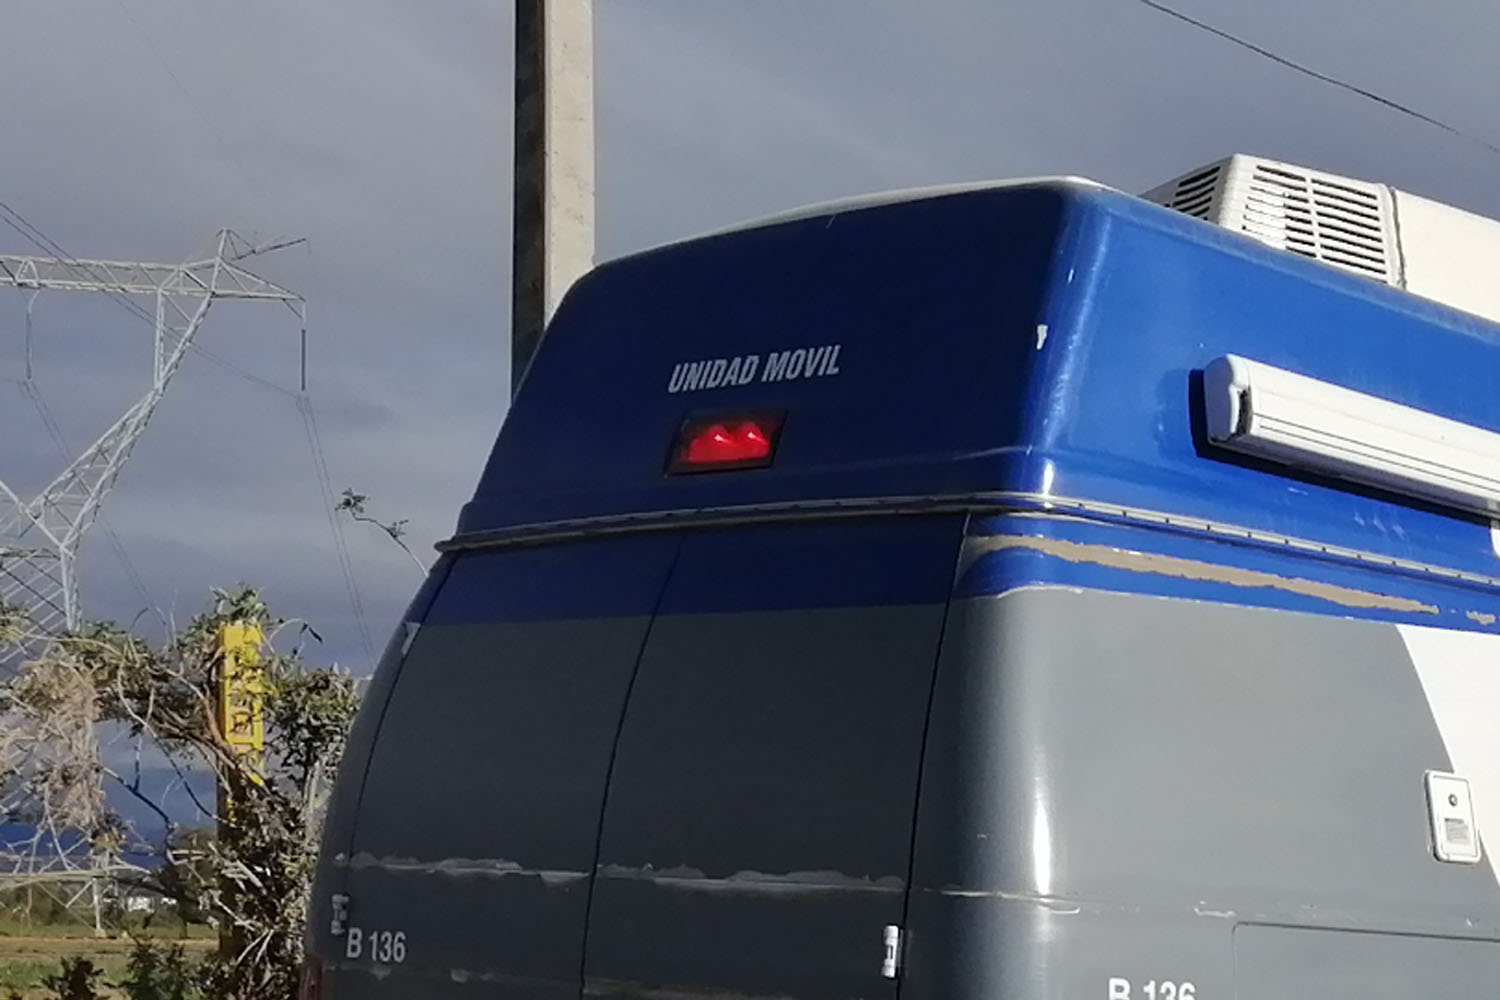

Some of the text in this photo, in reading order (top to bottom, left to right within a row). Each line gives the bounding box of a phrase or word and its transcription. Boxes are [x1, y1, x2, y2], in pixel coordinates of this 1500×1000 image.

[668, 344, 842, 394] UNIDAD MOVIL
[346, 927, 407, 963] B 136
